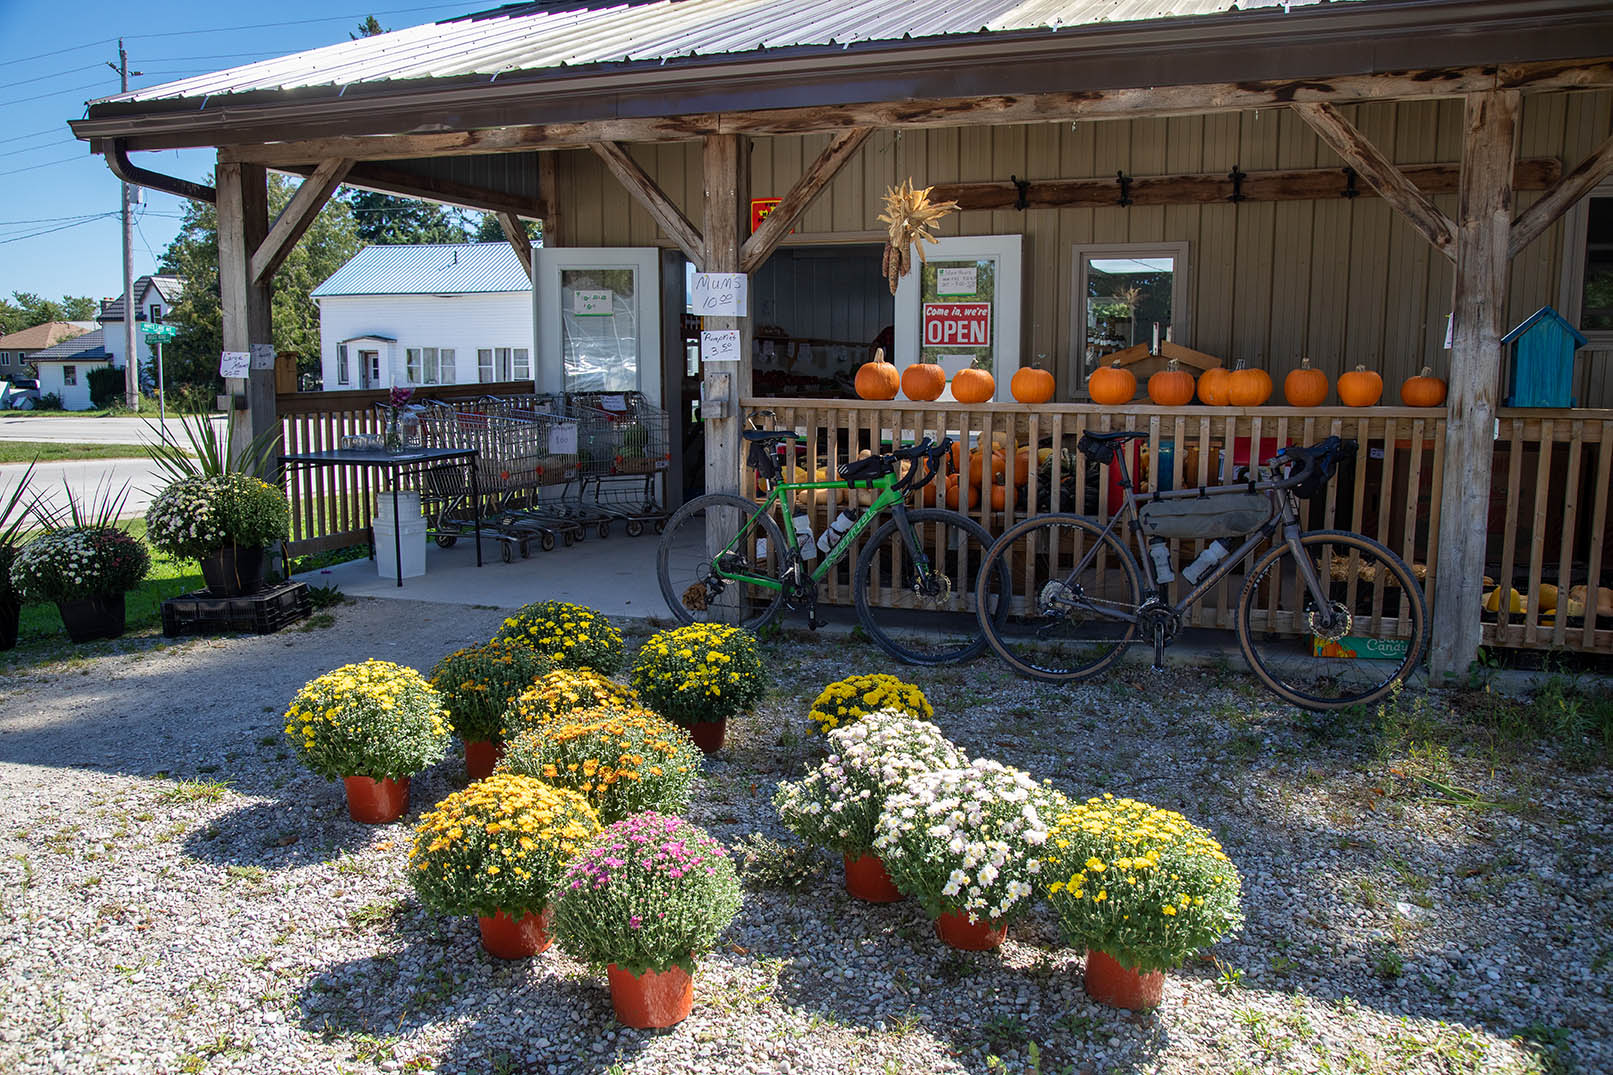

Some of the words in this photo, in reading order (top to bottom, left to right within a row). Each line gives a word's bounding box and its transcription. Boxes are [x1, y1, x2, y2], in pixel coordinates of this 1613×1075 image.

[926, 306, 949, 316] Come
[951, 306, 962, 317] in,
[964, 307, 987, 316] we're
[928, 320, 985, 343] OPEN
[1367, 638, 1408, 654] Candy
